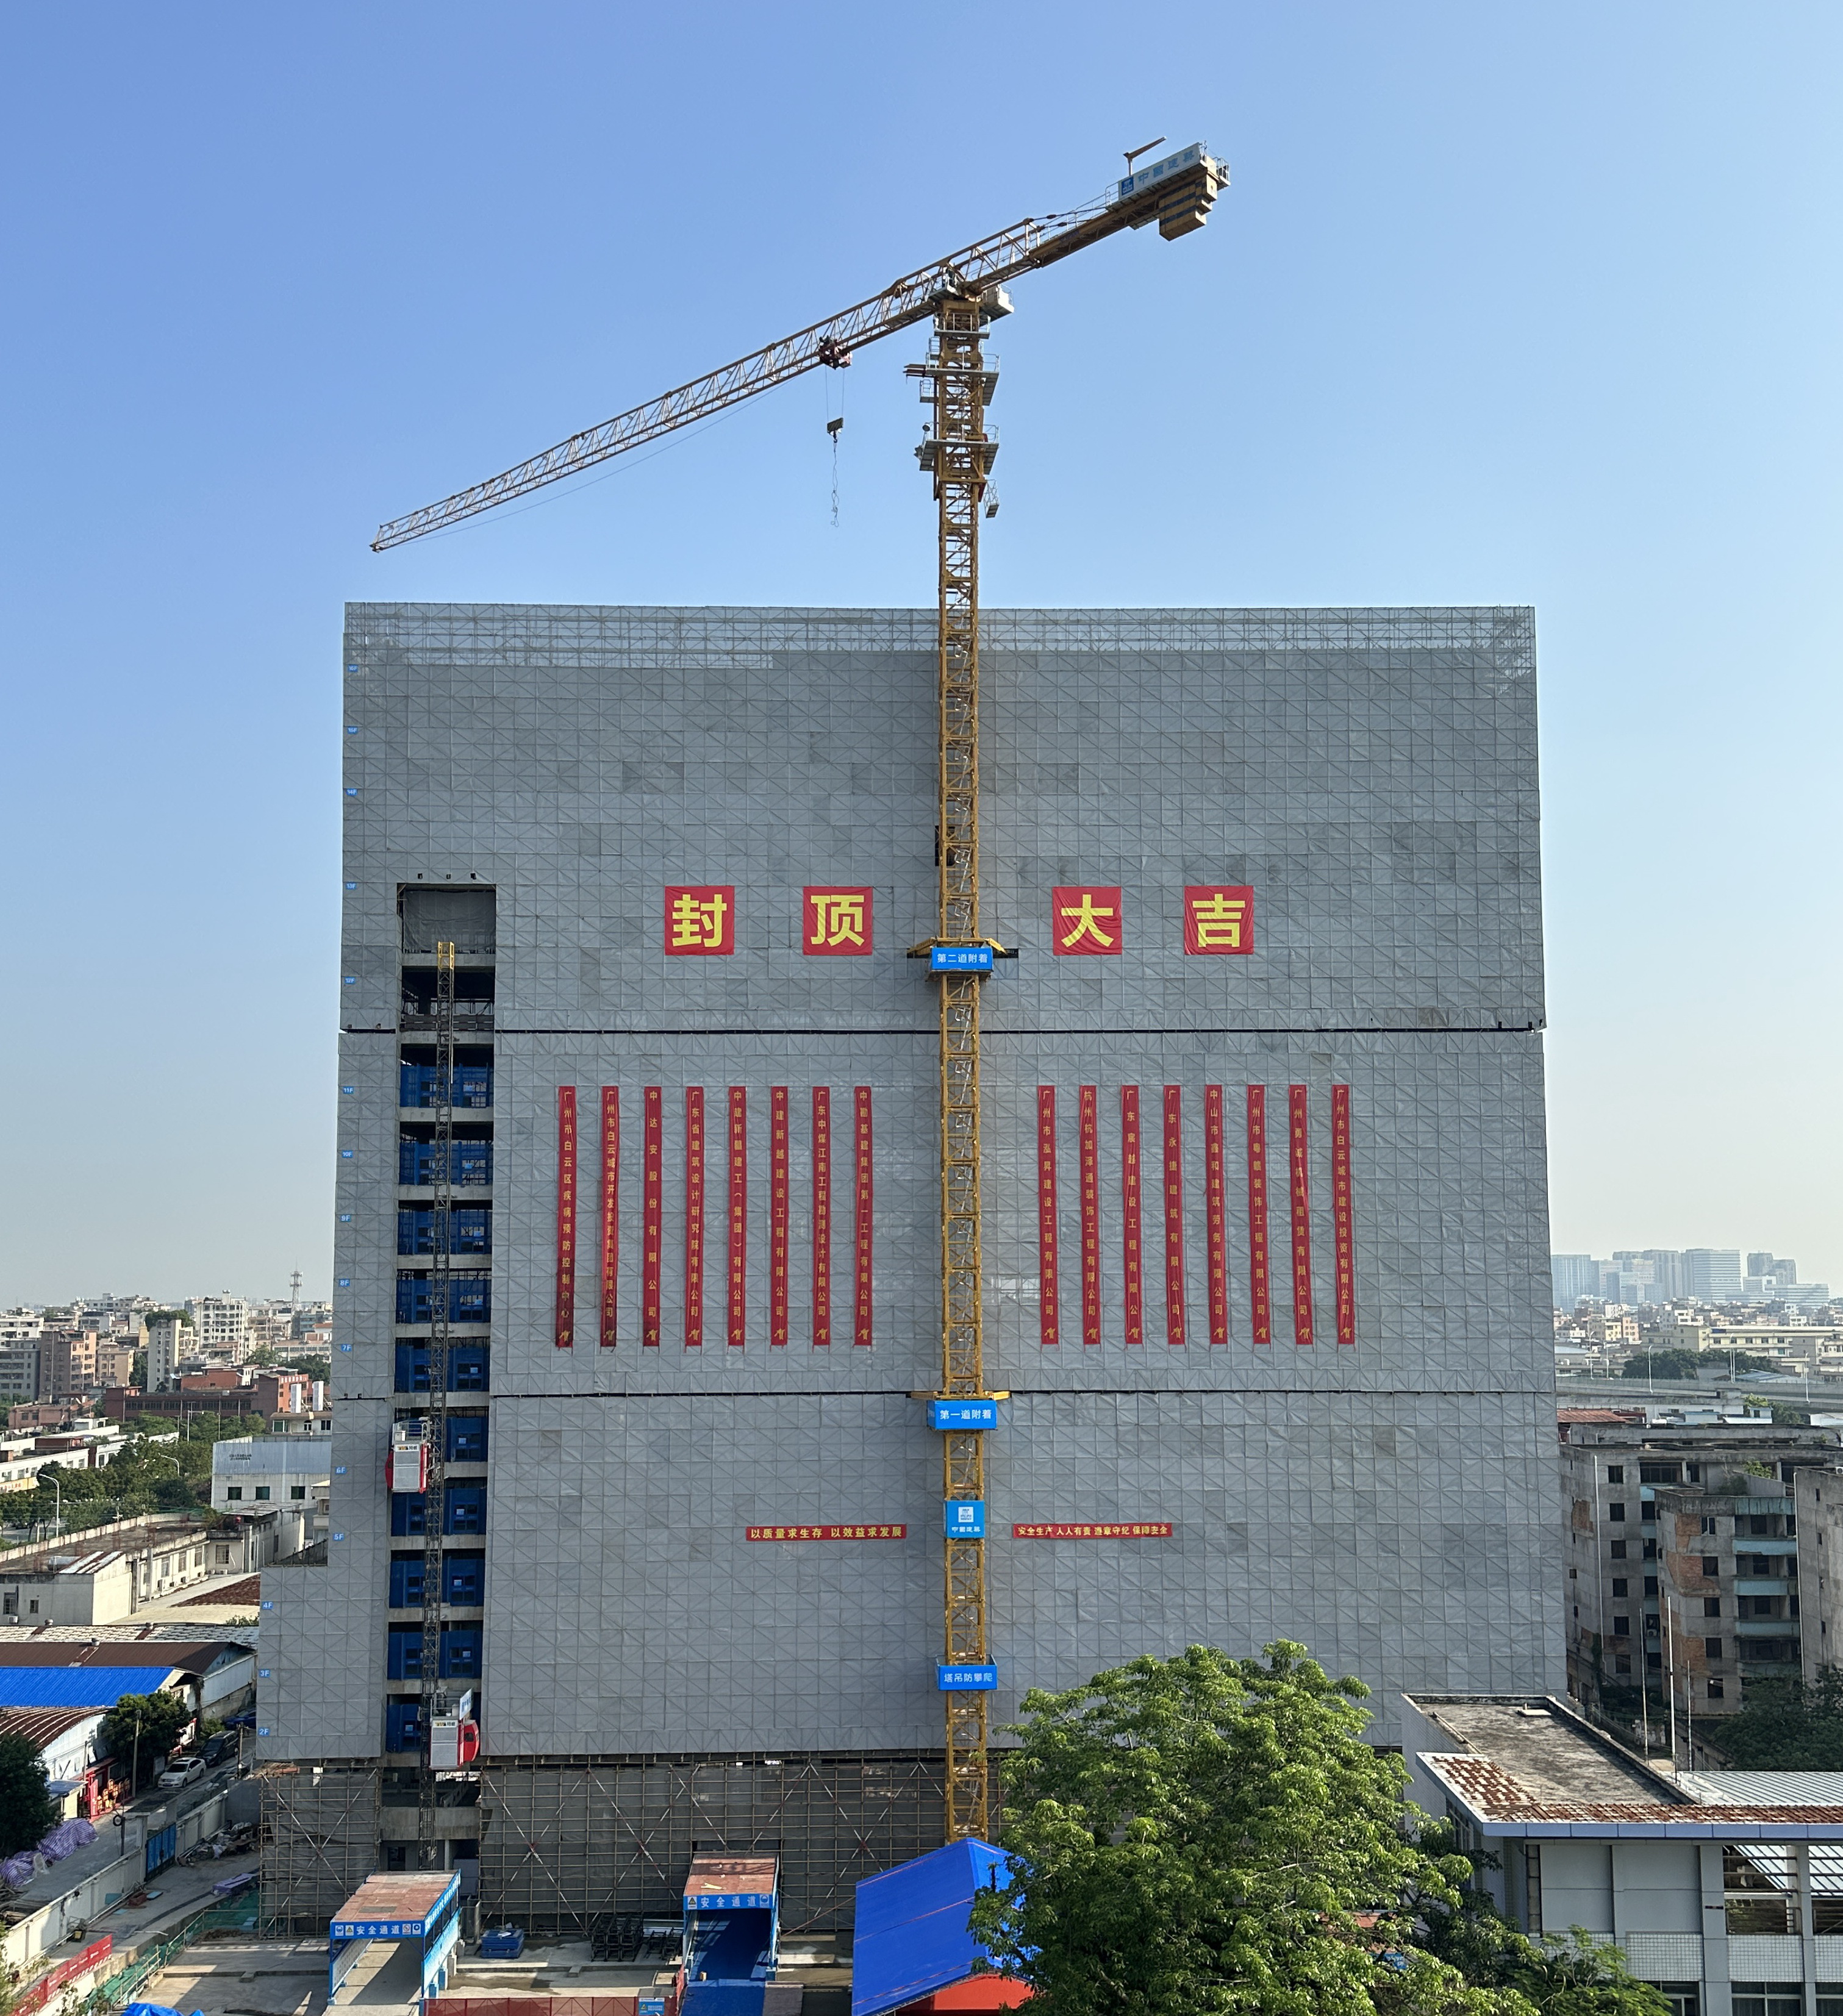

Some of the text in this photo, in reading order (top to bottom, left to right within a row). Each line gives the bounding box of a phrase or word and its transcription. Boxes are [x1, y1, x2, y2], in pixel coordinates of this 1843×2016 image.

[673, 894, 1244, 946] 封 顶 大 吉
[937, 954, 988, 963] 第二道附着
[940, 1409, 992, 1420] 第一道附着
[751, 1527, 902, 1539] 以质量求生存 以效益求发展
[944, 1673, 992, 1682] 塔吊防攀爬
[701, 1895, 756, 1908] 安全通道
[356, 1925, 400, 1935] 安全通道
